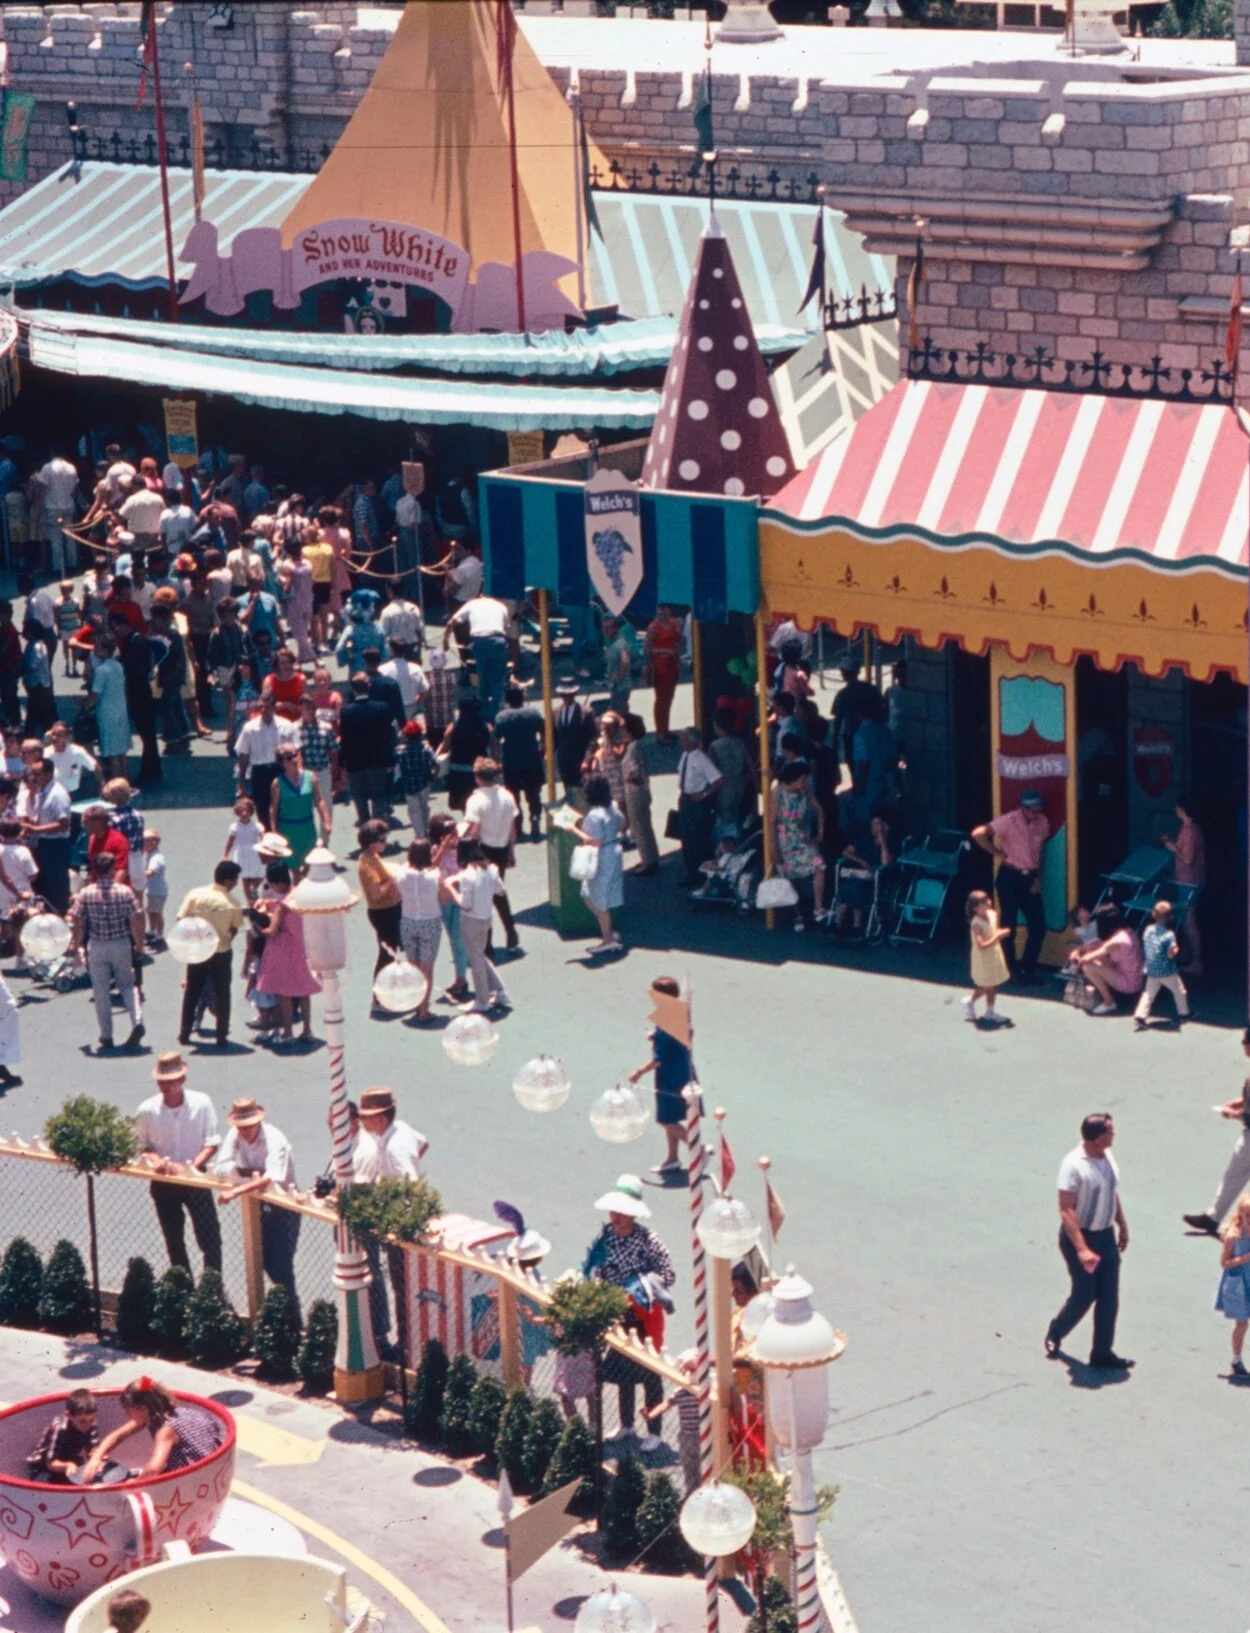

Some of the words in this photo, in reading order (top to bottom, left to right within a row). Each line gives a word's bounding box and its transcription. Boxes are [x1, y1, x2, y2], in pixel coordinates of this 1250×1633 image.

[302, 230, 370, 265] Snow
[369, 223, 458, 278] White
[319, 259, 340, 275] AND
[343, 258, 361, 270] HER
[366, 260, 435, 283] ADVENTURES
[589, 495, 634, 512] Welch's
[1002, 757, 1064, 777] Welch's
